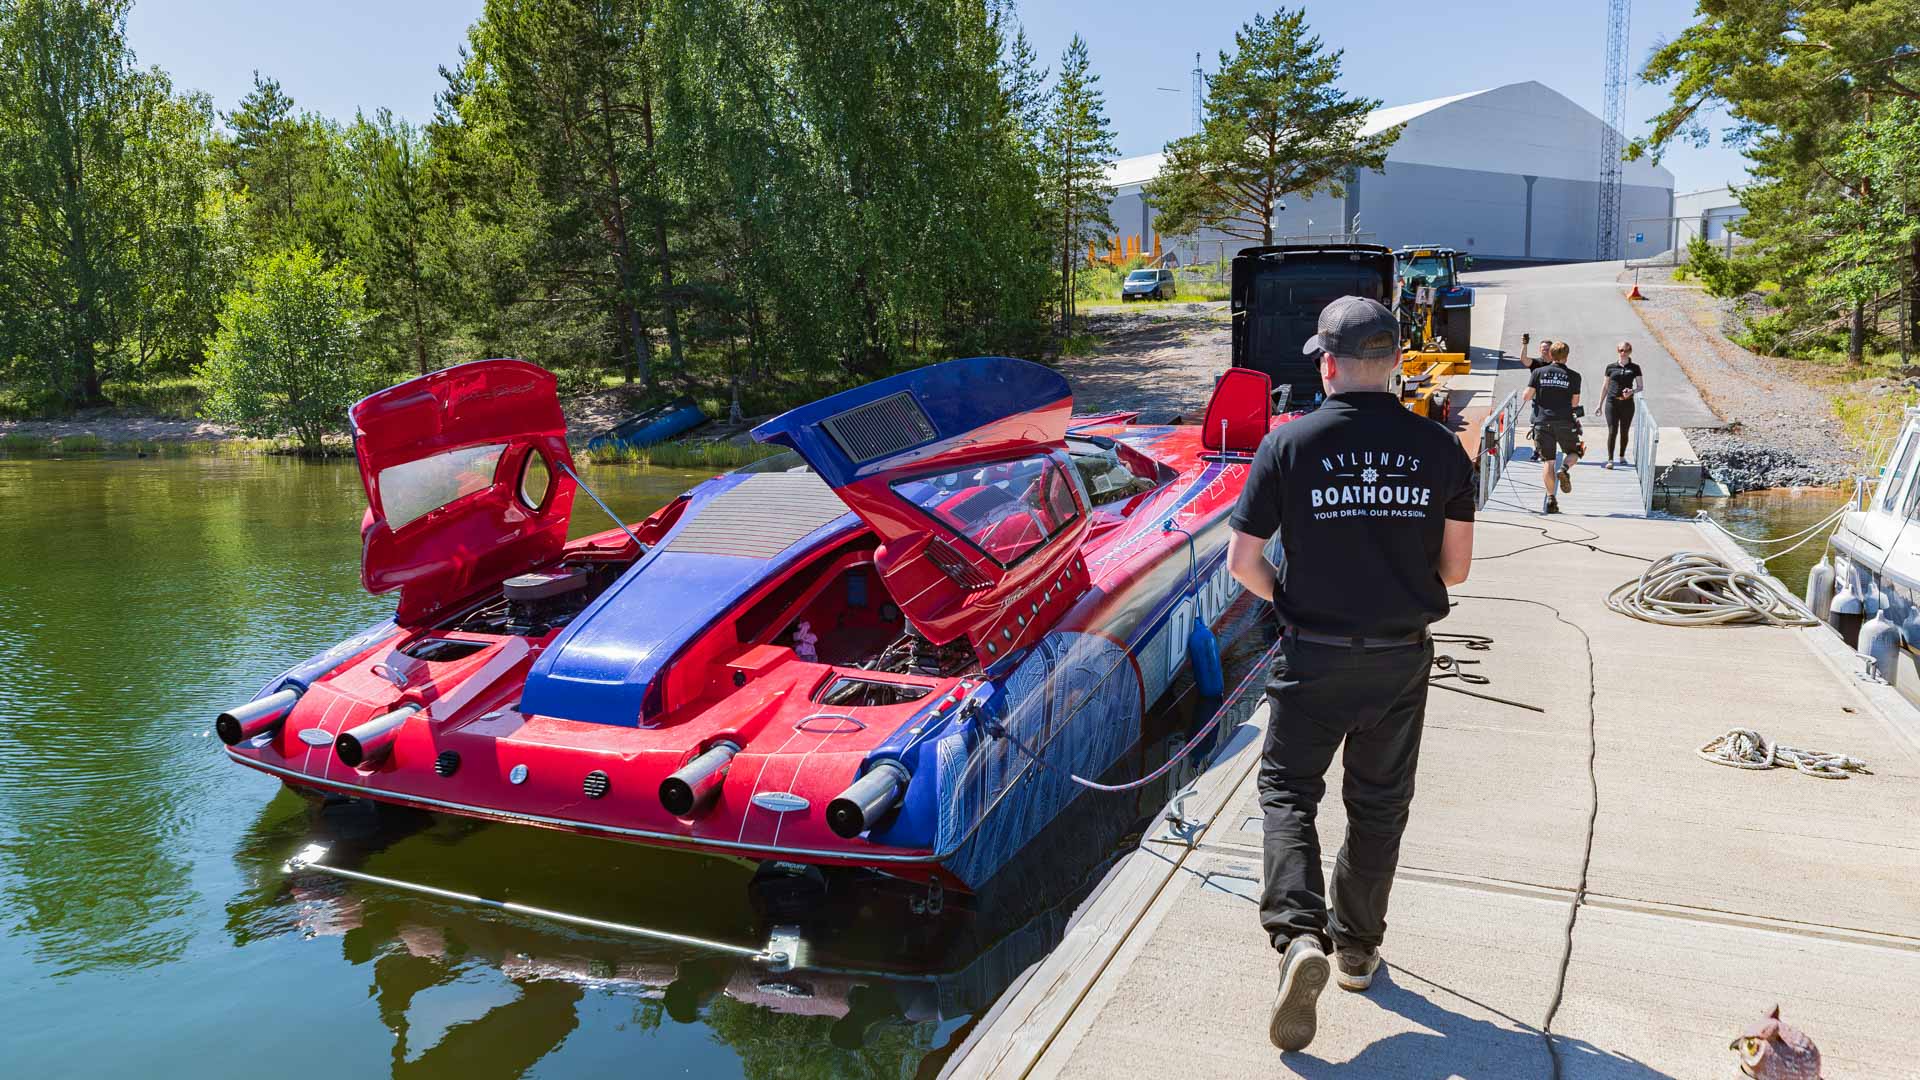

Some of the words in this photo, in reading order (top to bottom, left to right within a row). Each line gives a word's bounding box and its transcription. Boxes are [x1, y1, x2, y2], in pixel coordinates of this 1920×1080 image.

[1321, 451, 1420, 472] NYLUND'S
[1312, 486, 1430, 507] BOATHOUSE
[1314, 511, 1338, 520] YOUR
[1369, 509, 1389, 517] OUR
